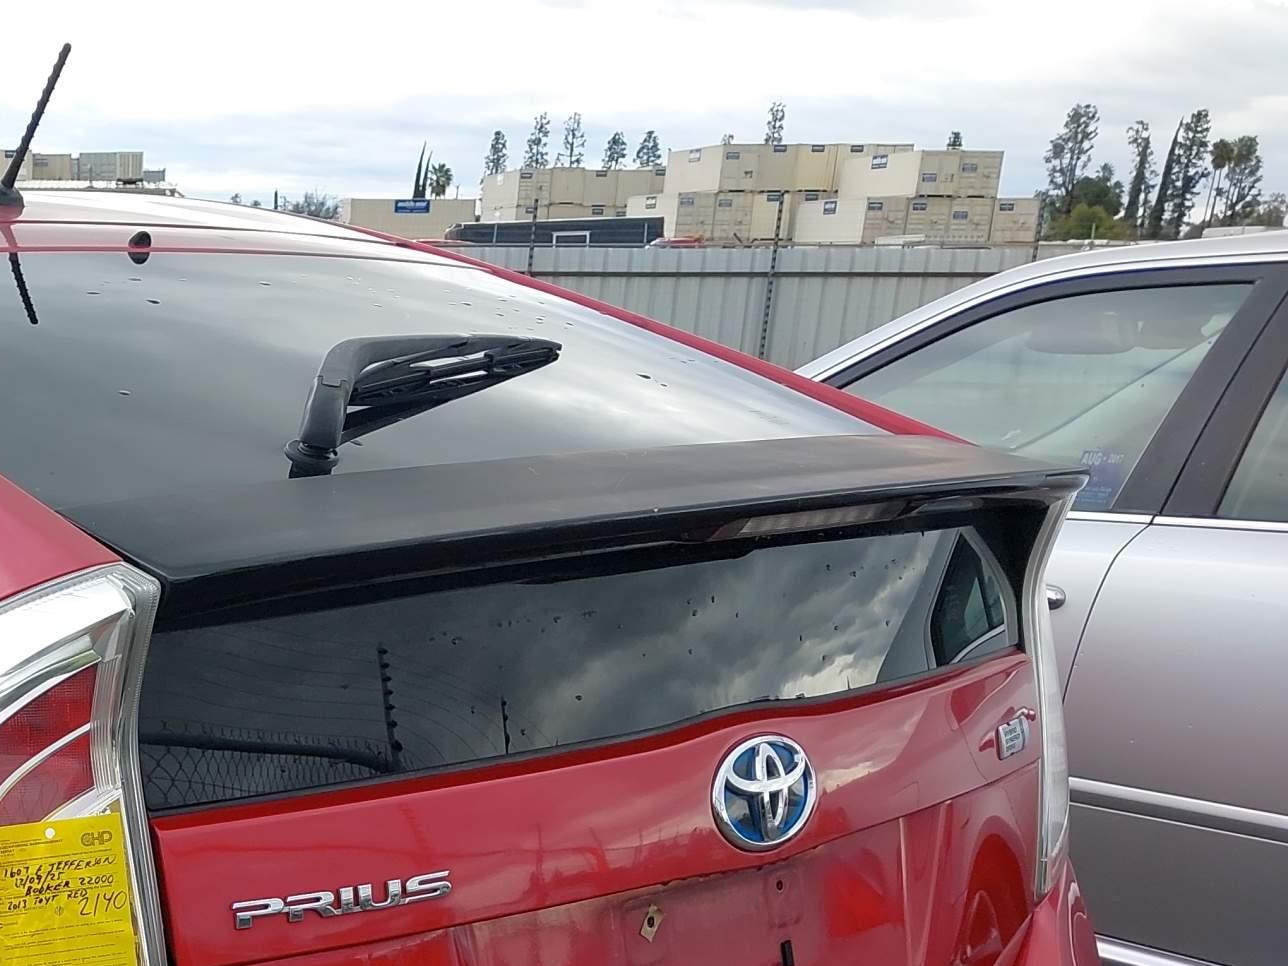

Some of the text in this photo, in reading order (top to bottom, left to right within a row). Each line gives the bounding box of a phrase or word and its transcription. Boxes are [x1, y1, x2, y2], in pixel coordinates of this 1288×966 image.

[1080, 450, 1103, 465] AUG
[80, 830, 113, 847] CHP
[48, 855, 117, 873] JEFFERSON
[78, 874, 114, 886] 22000
[66, 887, 89, 900] RED
[231, 869, 454, 930] PRIUS
